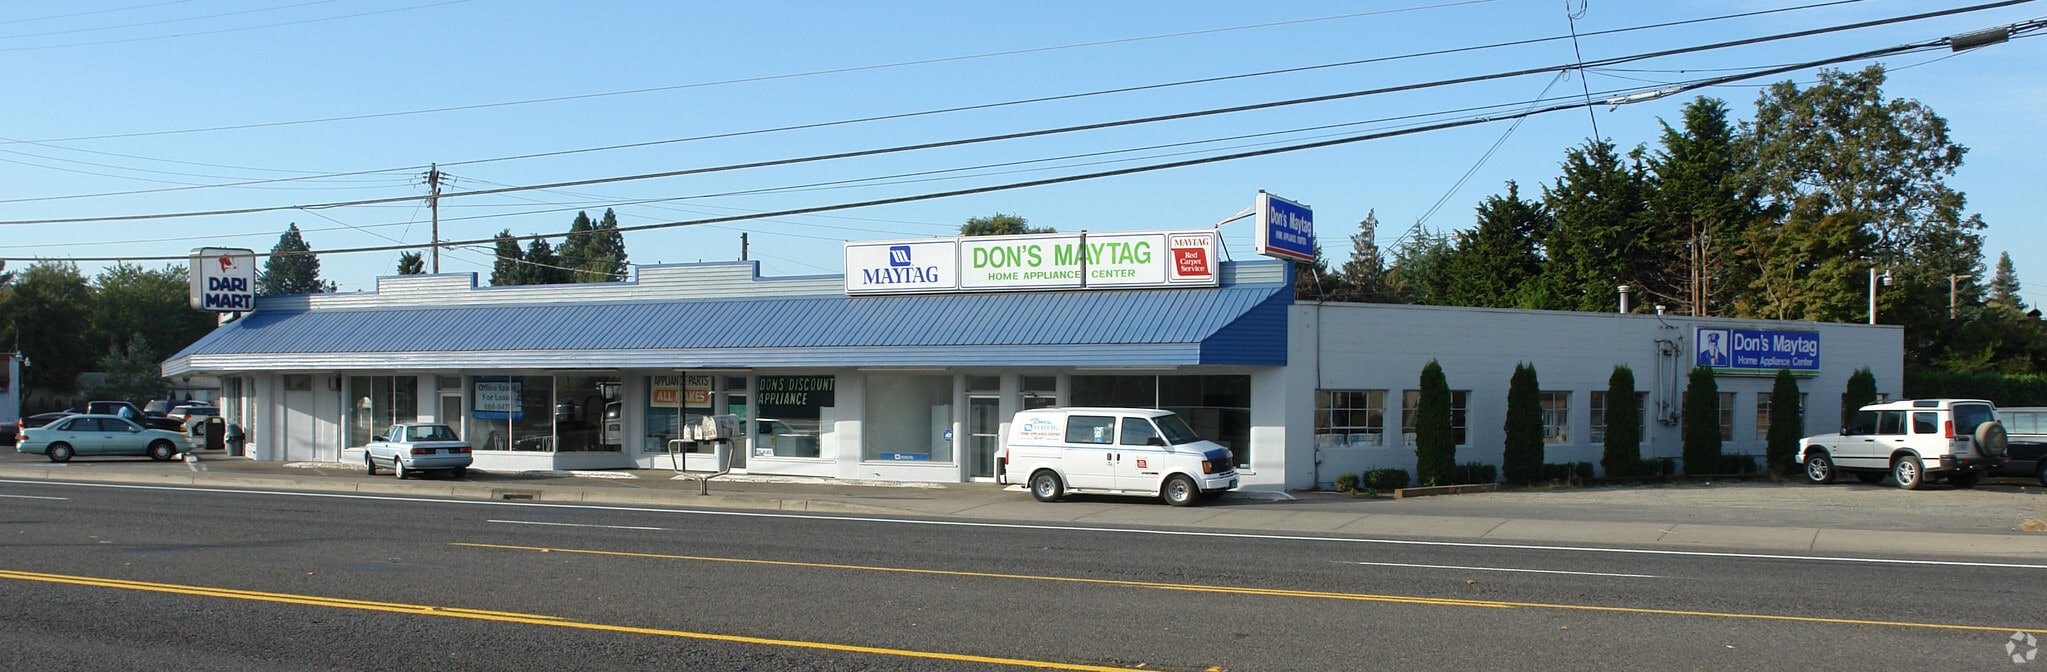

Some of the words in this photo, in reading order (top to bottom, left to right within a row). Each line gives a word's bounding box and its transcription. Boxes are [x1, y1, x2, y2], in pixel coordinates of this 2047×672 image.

[1270, 206, 1288, 228] Don's
[1290, 211, 1312, 238] Maytag
[1174, 238, 1209, 247] MAYTAG
[973, 244, 1042, 268] DON'S
[1054, 241, 1151, 267] MAYTAG
[1180, 258, 1202, 266] Carpet
[1180, 264, 1205, 273] Service
[862, 266, 938, 284] MAYTAG
[988, 272, 1019, 281] HOME
[1023, 270, 1081, 280] APPLIANCE
[1091, 269, 1136, 279] CENTER
[208, 277, 248, 291] DARI
[205, 293, 252, 309] MART
[1734, 333, 1769, 352] Don's
[1773, 335, 1818, 357] Maytag
[1738, 355, 1758, 365] Home
[1760, 356, 1791, 368] Appliance
[1792, 357, 1814, 367] Center
[654, 375, 687, 387] APPLIANC
[688, 376, 709, 387] PARTS
[789, 377, 835, 391] DISCOUNT
[657, 390, 676, 402] ALL
[758, 392, 808, 405] APPLIANCE
